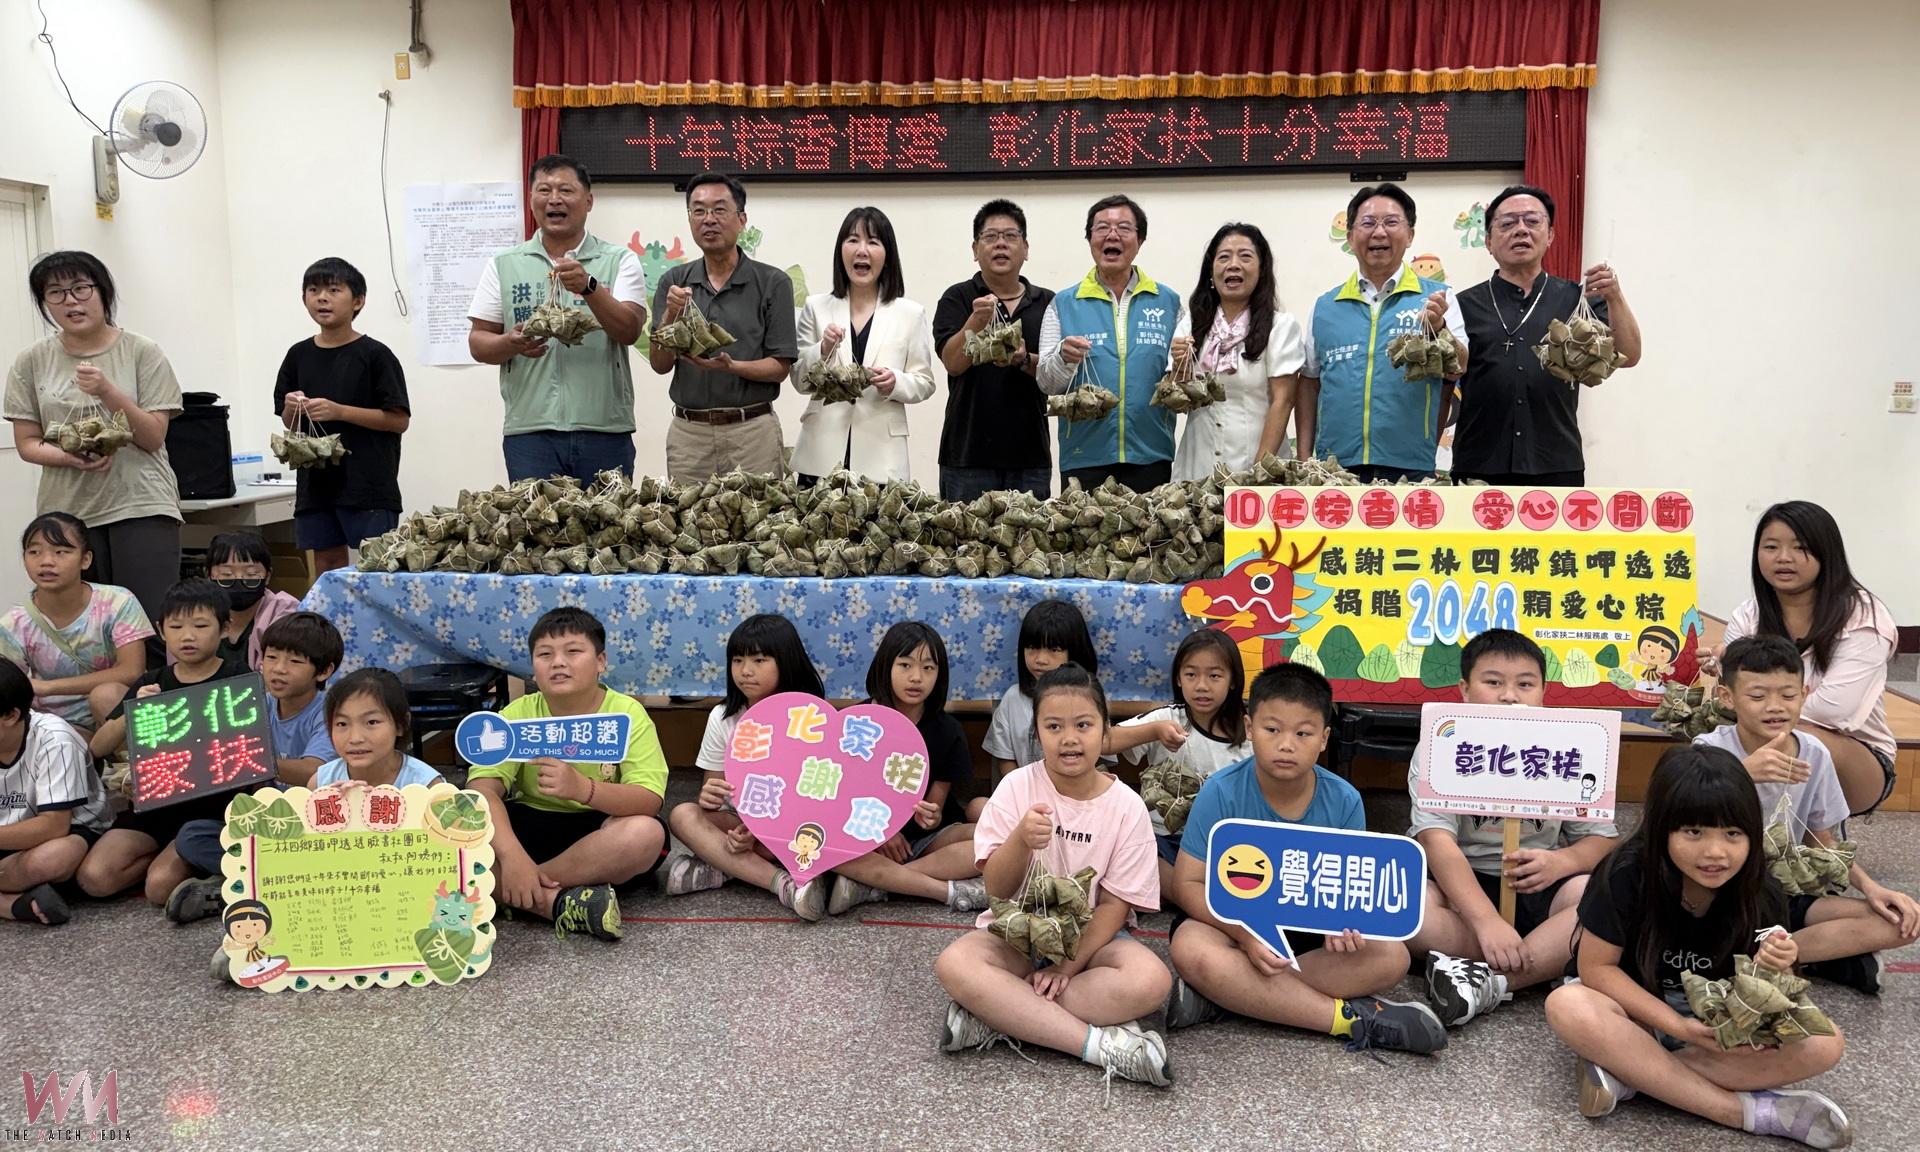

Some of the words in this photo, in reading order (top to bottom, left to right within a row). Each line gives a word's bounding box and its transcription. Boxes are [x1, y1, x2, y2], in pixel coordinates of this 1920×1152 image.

[989, 101, 1450, 167] 彰化家扶十分幸福
[1231, 490, 1438, 527] 10年粽香情
[1474, 491, 1691, 529] 愛心不間斷
[1319, 546, 1692, 580] 感謝二林四鄉鎮呷透透
[1535, 630, 1609, 641] 彰化家扶二林服務處
[1614, 631, 1631, 641] 敬上
[520, 719, 619, 745] 活動超讚
[1455, 741, 1583, 780] 彰化家扶
[313, 794, 401, 827] 感謝
[1277, 849, 1408, 913] 覺得開心
